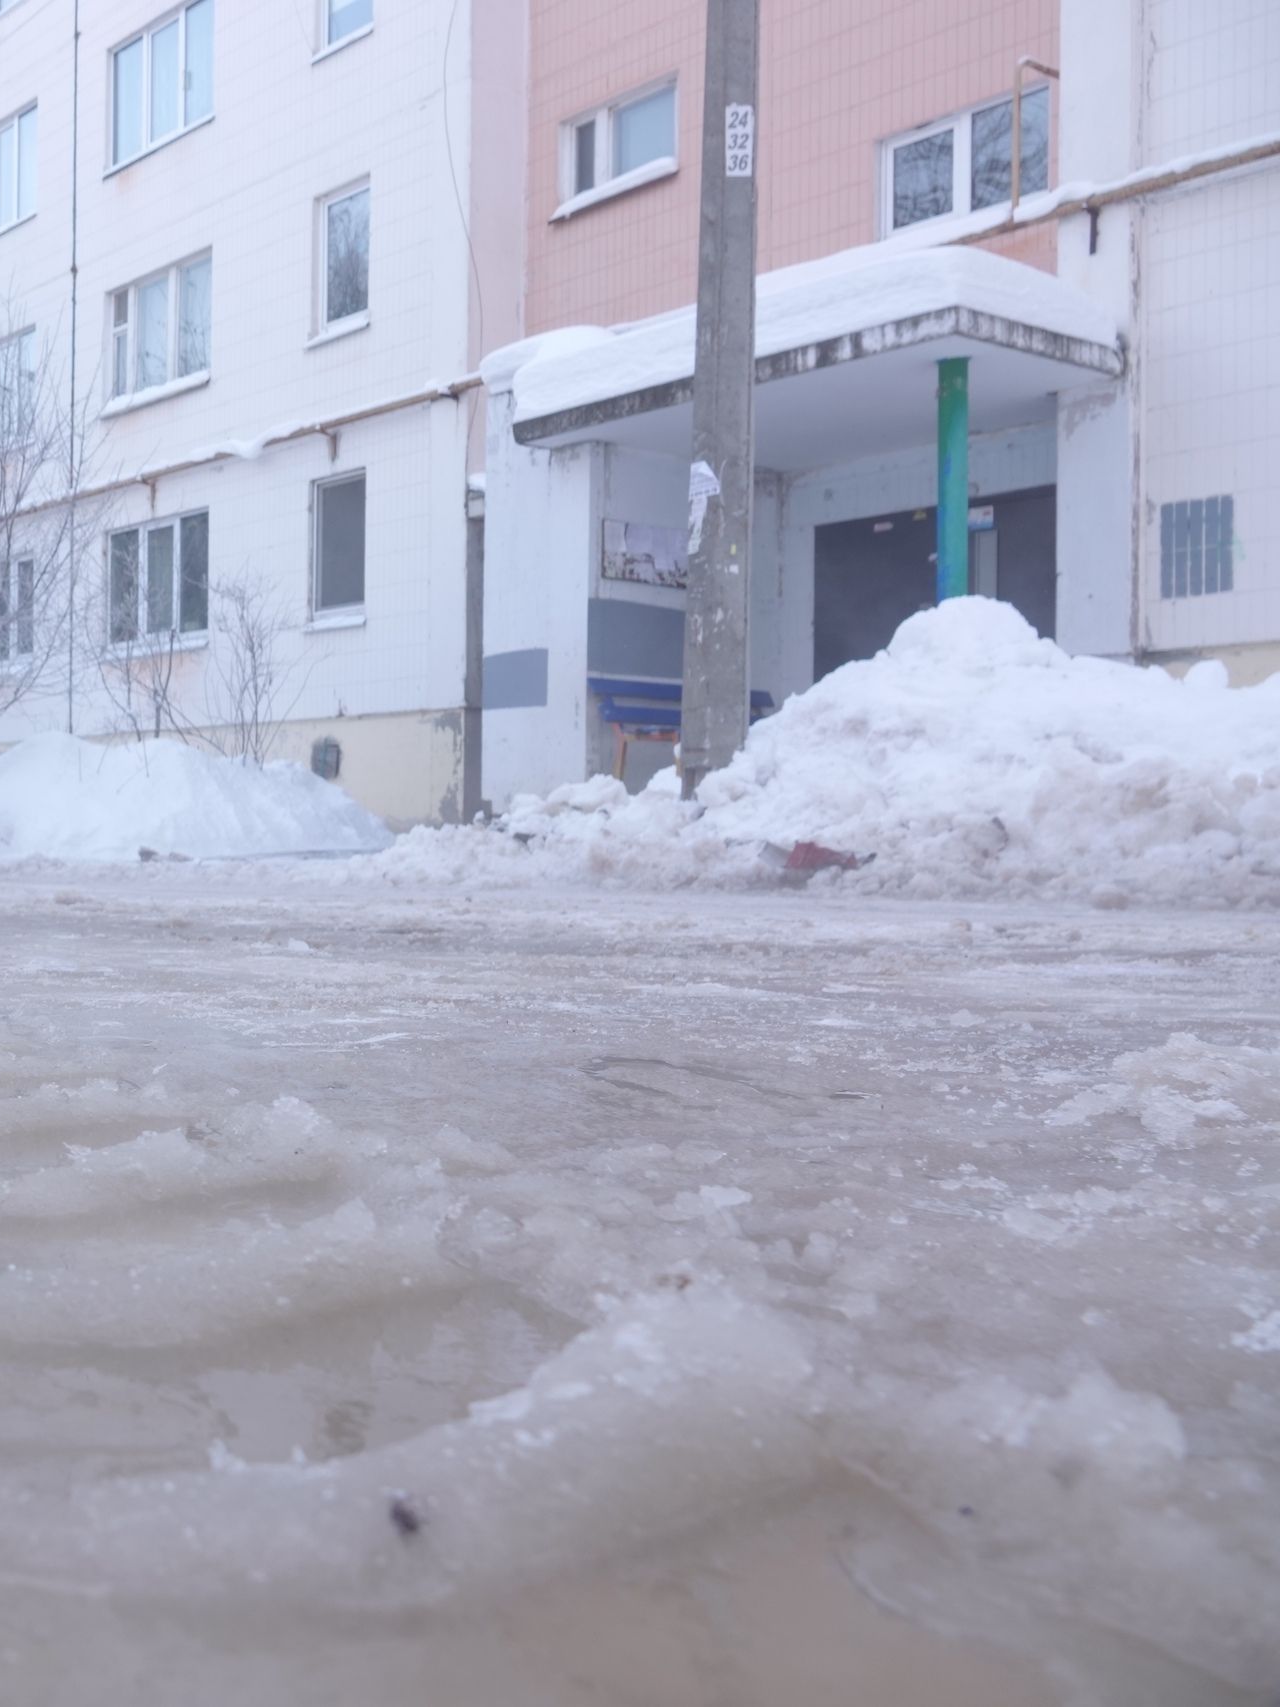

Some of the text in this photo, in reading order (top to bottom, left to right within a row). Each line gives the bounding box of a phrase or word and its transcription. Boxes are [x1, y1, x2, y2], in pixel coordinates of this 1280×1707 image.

[728, 110, 749, 129] 24
[728, 133, 750, 150] 32
[728, 154, 750, 172] 36
